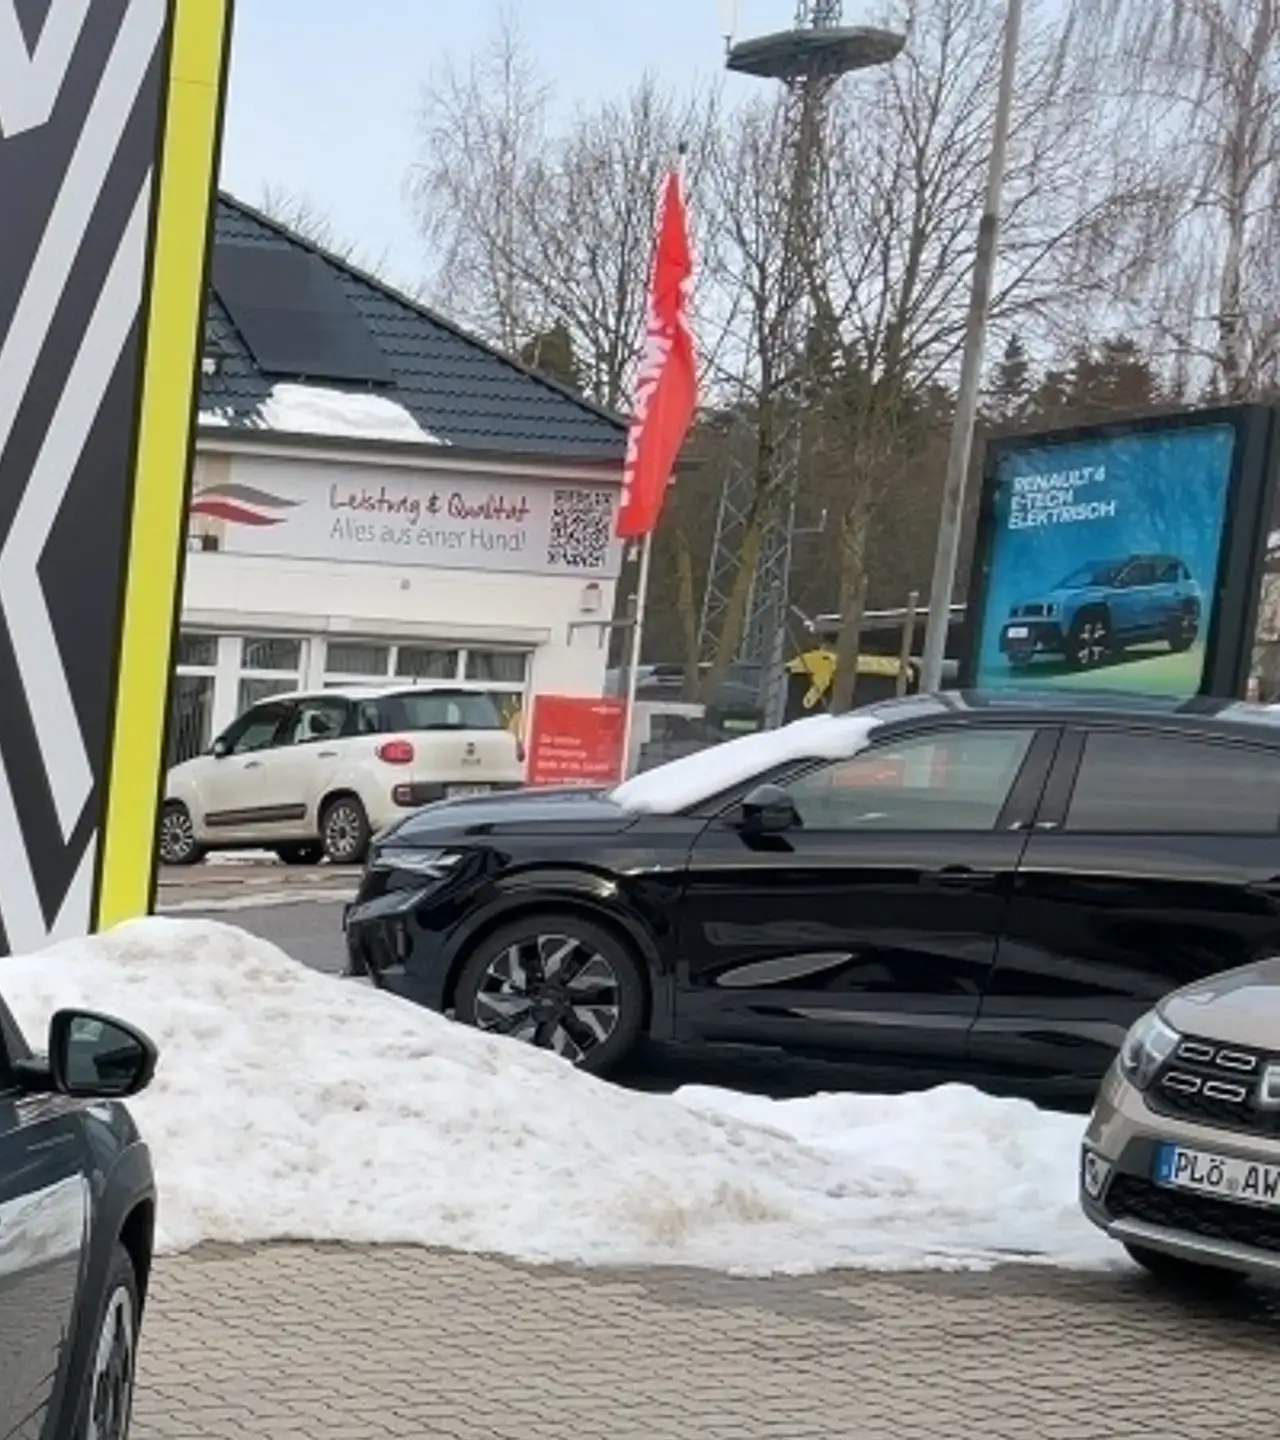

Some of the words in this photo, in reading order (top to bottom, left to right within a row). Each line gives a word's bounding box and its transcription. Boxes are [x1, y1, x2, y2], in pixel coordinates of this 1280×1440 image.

[1012, 467, 1093, 494] RENAULT
[1094, 464, 1106, 482] 4
[330, 484, 420, 525] Leistung
[1007, 500, 1116, 529] ELEKTRISCH
[1011, 489, 1074, 510] E-TECH
[330, 517, 376, 542] Alles
[380, 525, 411, 546] aus
[416, 528, 466, 549] einer
[470, 531, 526, 552] Hand!
[1175, 1151, 1224, 1187] PLÖ
[1242, 1162, 1280, 1199] AW
